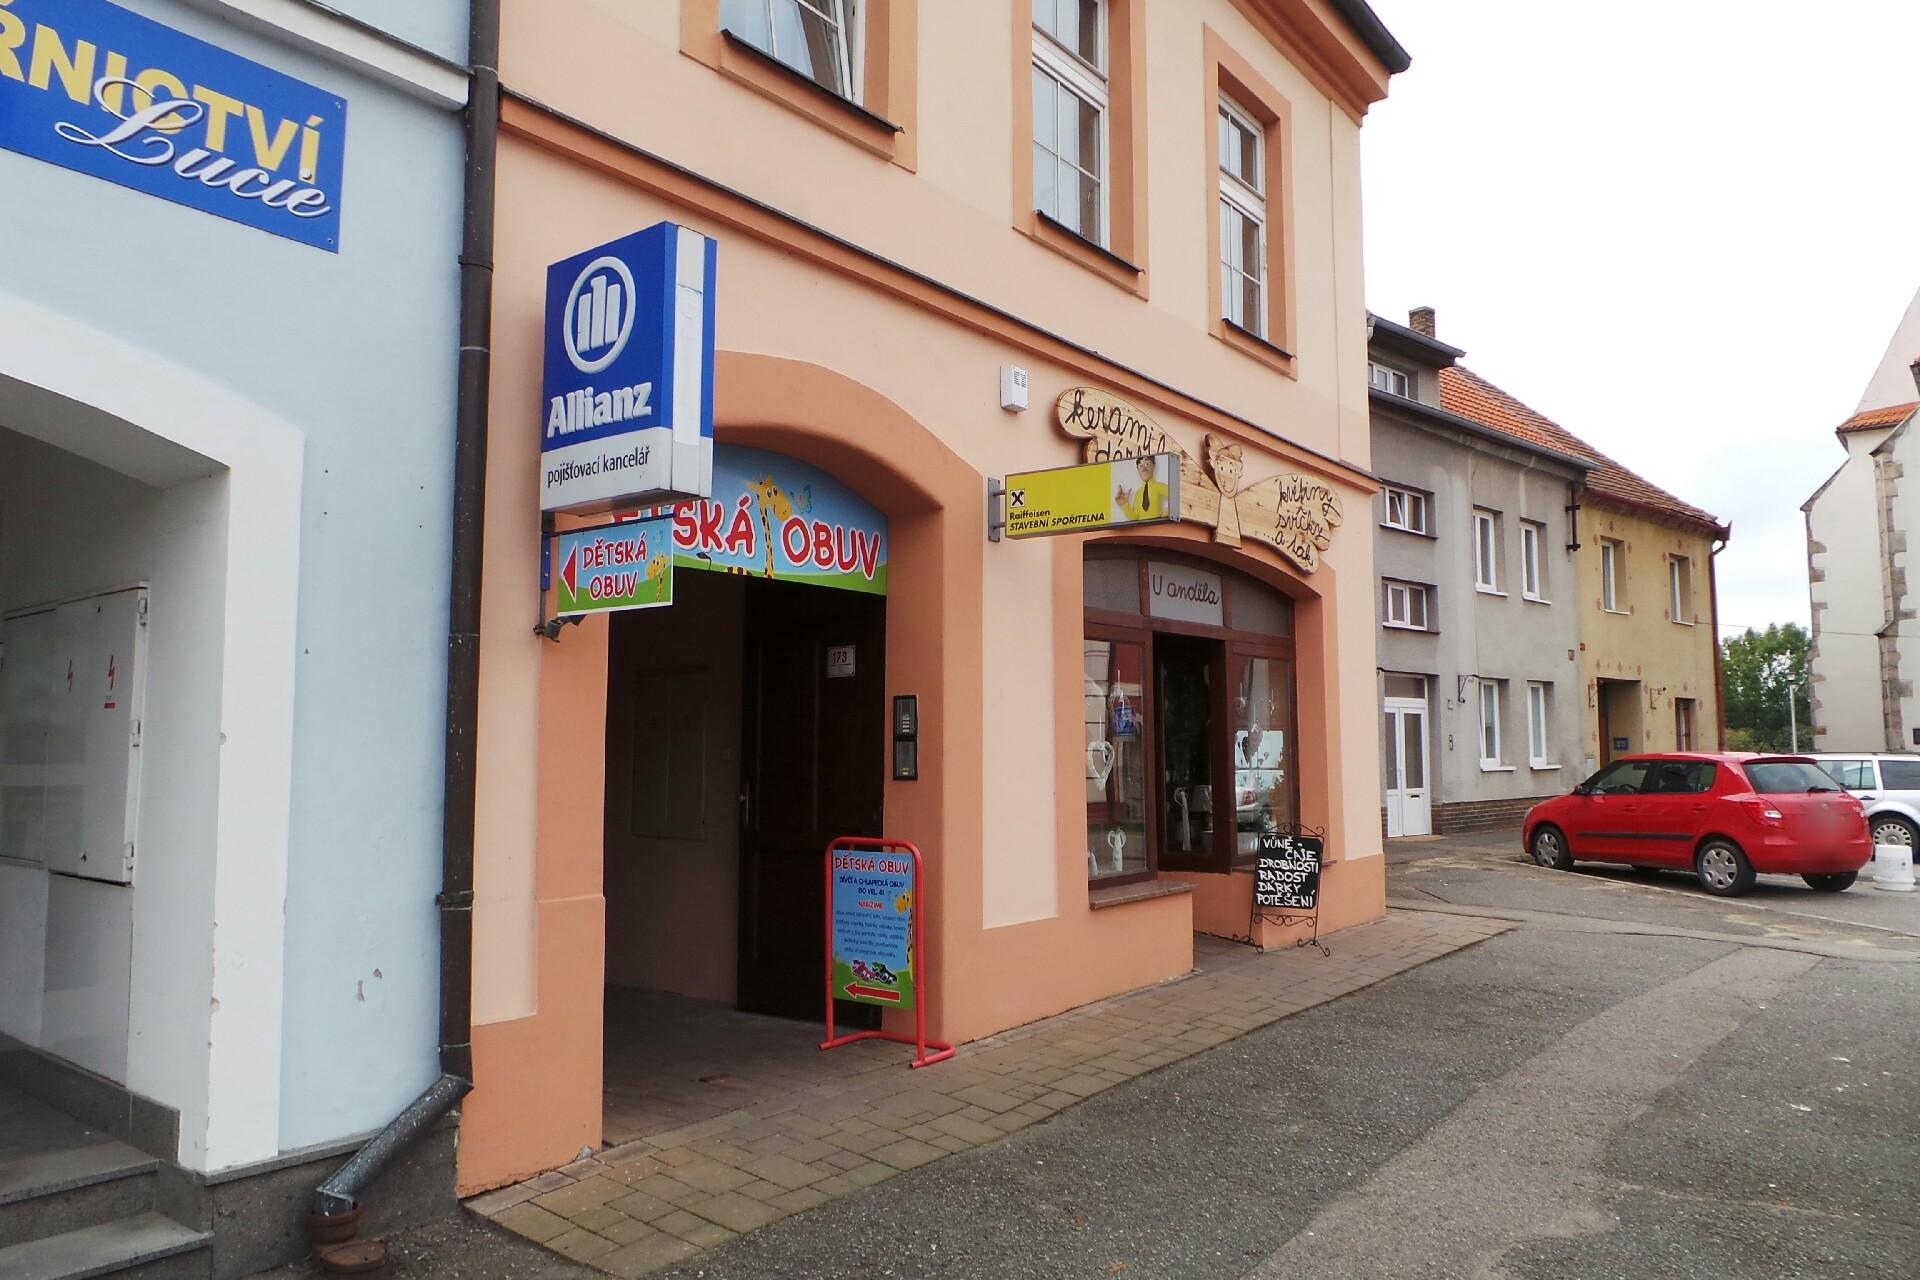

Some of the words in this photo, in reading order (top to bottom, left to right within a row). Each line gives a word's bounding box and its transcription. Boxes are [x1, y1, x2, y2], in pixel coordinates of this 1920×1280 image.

[55, 76, 331, 217] Lucie
[547, 382, 652, 438] Allianz
[547, 456, 600, 488] pojišťovací
[602, 446, 650, 473] kancelář
[1010, 509, 1050, 520] Raiffeisen
[1010, 517, 1049, 531] STAVEBNÍ
[1051, 512, 1105, 527] SPOŘITELNA
[582, 532, 648, 570] DĚTSKÁ
[781, 516, 879, 580] OBUV
[589, 571, 638, 600] OBUV
[1152, 573, 1162, 596] U
[1167, 581, 1219, 605] anděla
[1263, 836, 1293, 850] VŮNĚ
[834, 854, 875, 872] DĚTSKÁ
[878, 859, 910, 875] OBUV
[1285, 847, 1318, 862] ČAJE
[1259, 857, 1319, 874] DROBNOSTI
[1257, 869, 1308, 883] RADOST
[1257, 880, 1301, 894] DÁRKY
[1256, 889, 1316, 908] POTĚŠENÍ
